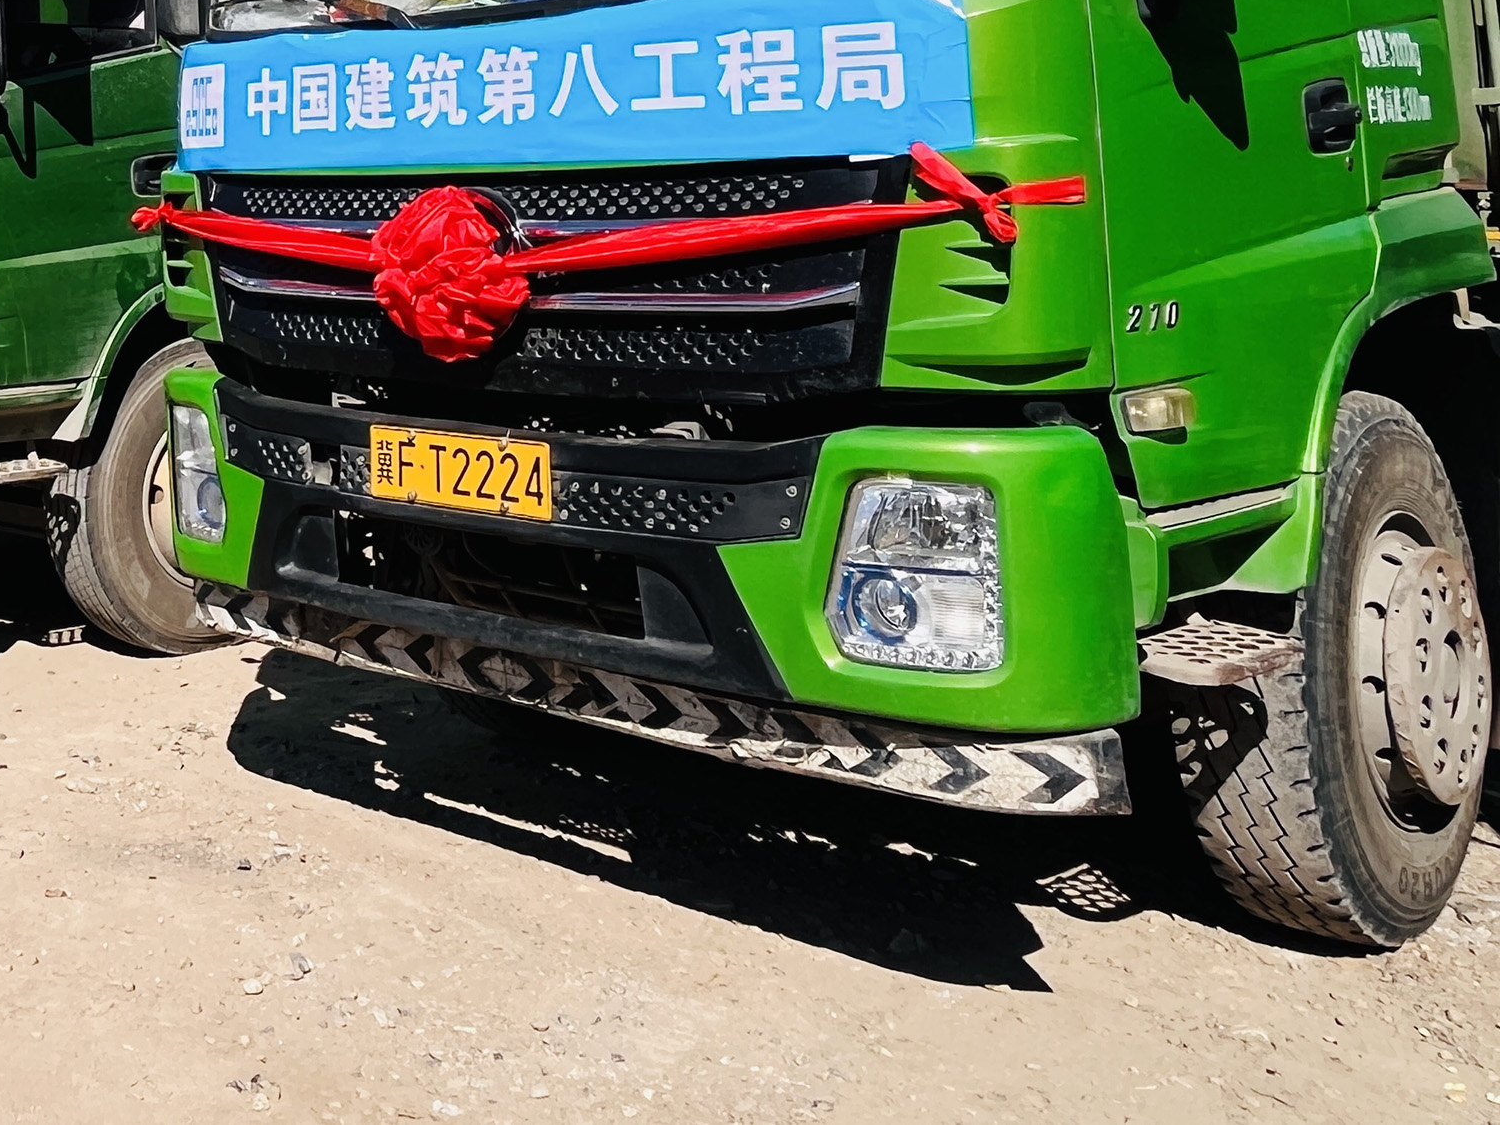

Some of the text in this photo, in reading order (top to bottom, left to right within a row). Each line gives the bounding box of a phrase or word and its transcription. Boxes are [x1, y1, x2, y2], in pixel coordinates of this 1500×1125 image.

[247, 22, 906, 136] 中国建筑第八工程局
